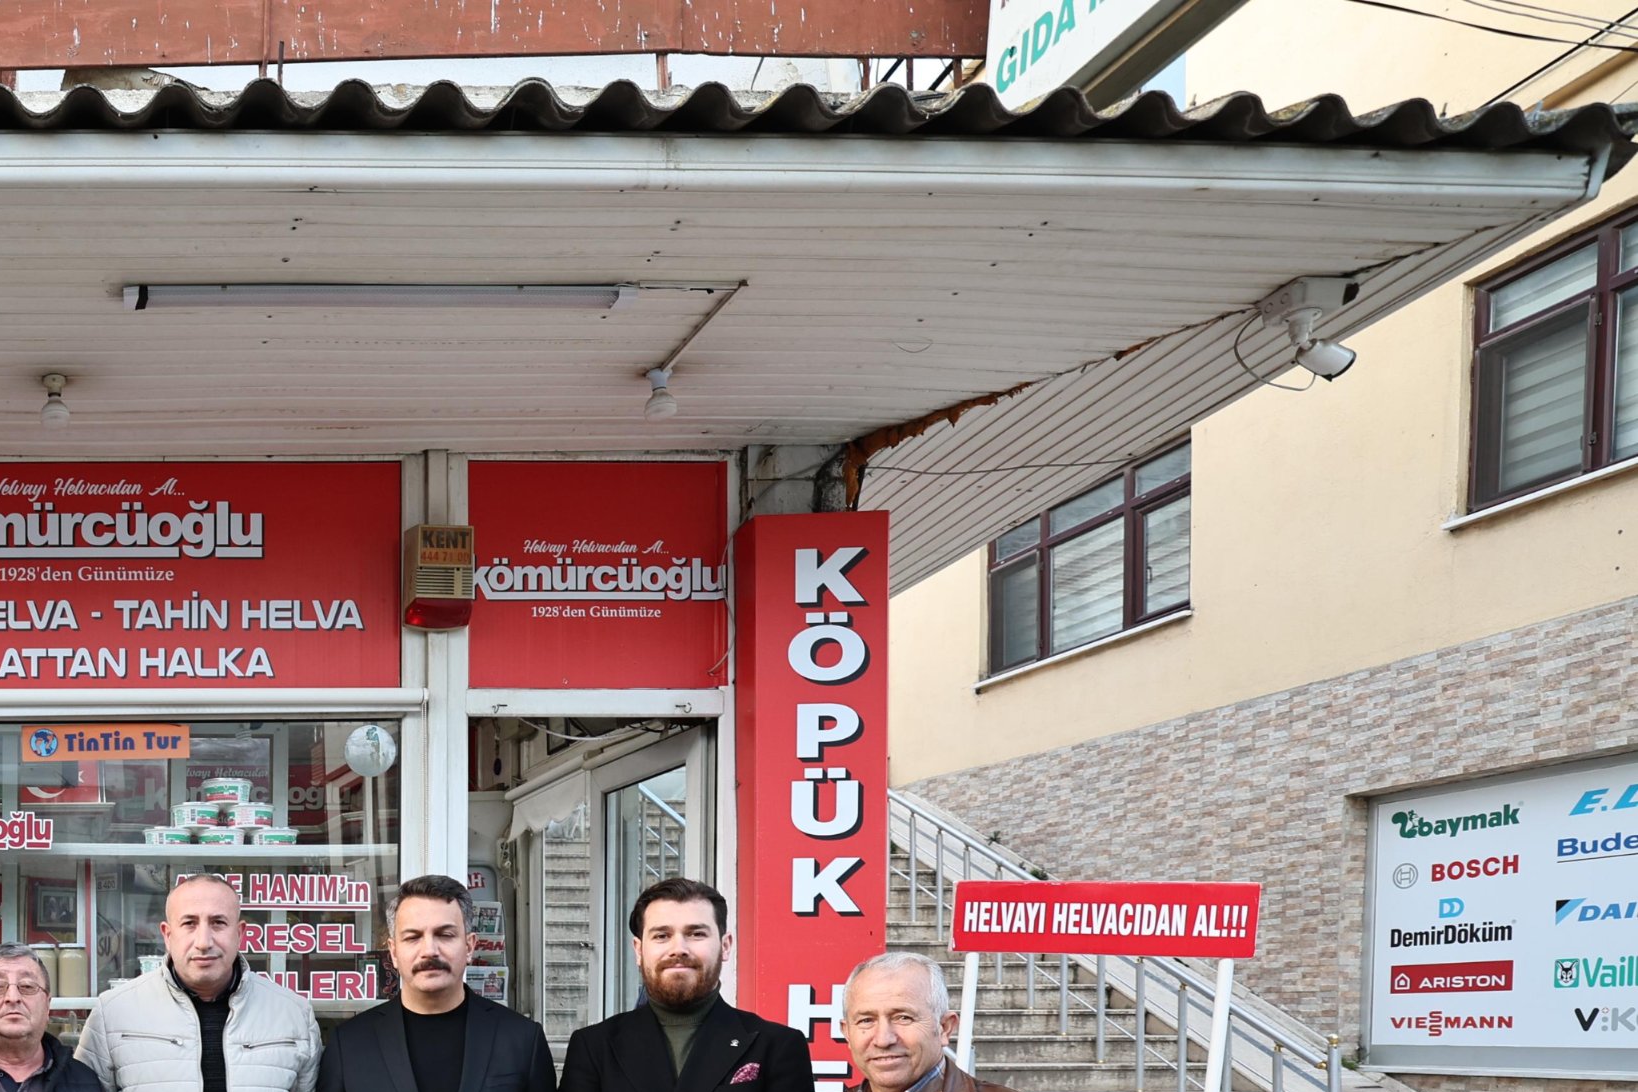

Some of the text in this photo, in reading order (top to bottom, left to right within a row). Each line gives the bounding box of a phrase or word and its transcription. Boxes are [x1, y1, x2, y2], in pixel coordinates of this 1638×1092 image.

[77, 566, 175, 584] Günümüze
[113, 590, 229, 630] TAHİN
[241, 598, 364, 630] HELVA
[531, 605, 661, 619] 1928'den Günümüze
[139, 647, 274, 678] HALKA
[64, 731, 181, 752] TinTin Tur
[786, 546, 866, 914] KÖPÜK
[1417, 803, 1521, 838] baymak
[1431, 854, 1520, 883] BOSCH
[963, 901, 1249, 938] HELVAYI HELVACIDAN AL!!!
[239, 924, 366, 954] RESEL
[1390, 921, 1513, 948] DemirDöküm
[1418, 974, 1506, 989] ARISTON
[1389, 1010, 1514, 1037] VIESSMANN
